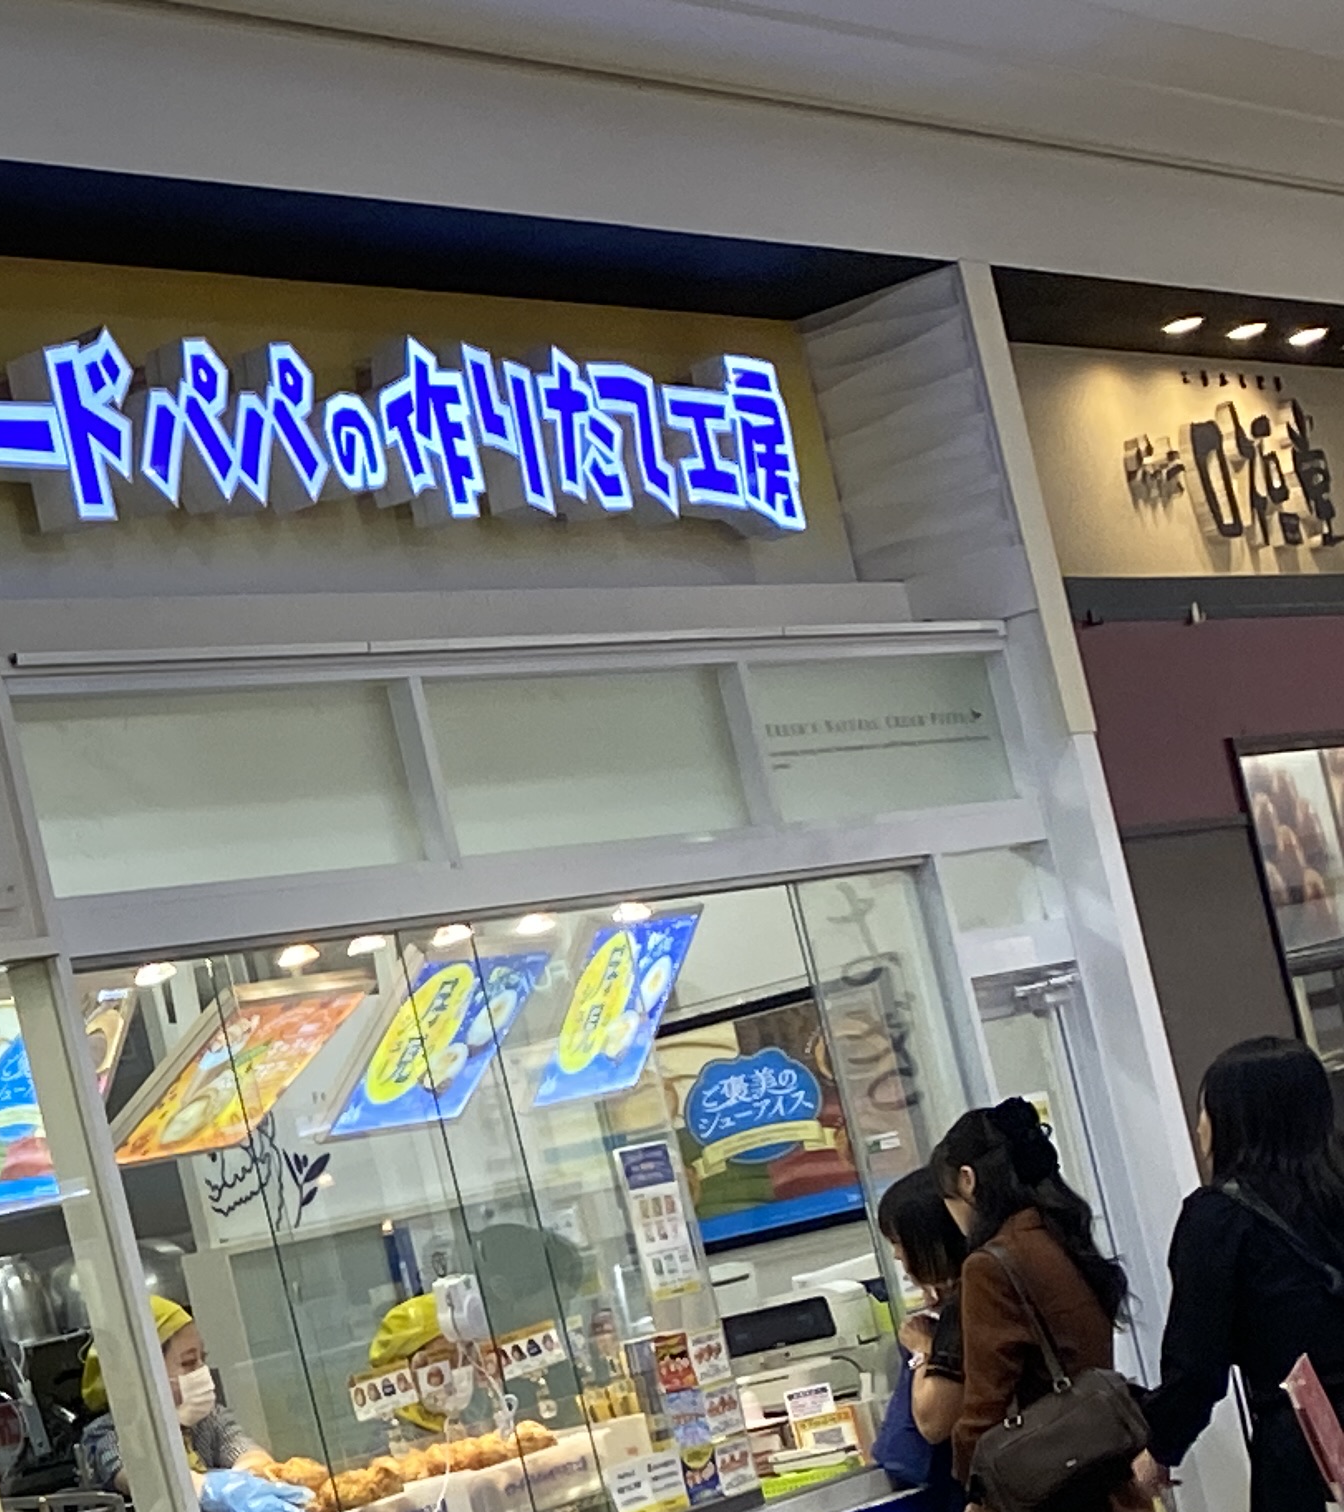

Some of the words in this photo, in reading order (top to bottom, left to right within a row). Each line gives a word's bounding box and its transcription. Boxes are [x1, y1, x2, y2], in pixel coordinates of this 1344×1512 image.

[701, 1065, 799, 1114] ご褒美の
[698, 1090, 815, 1139] シューアイス
